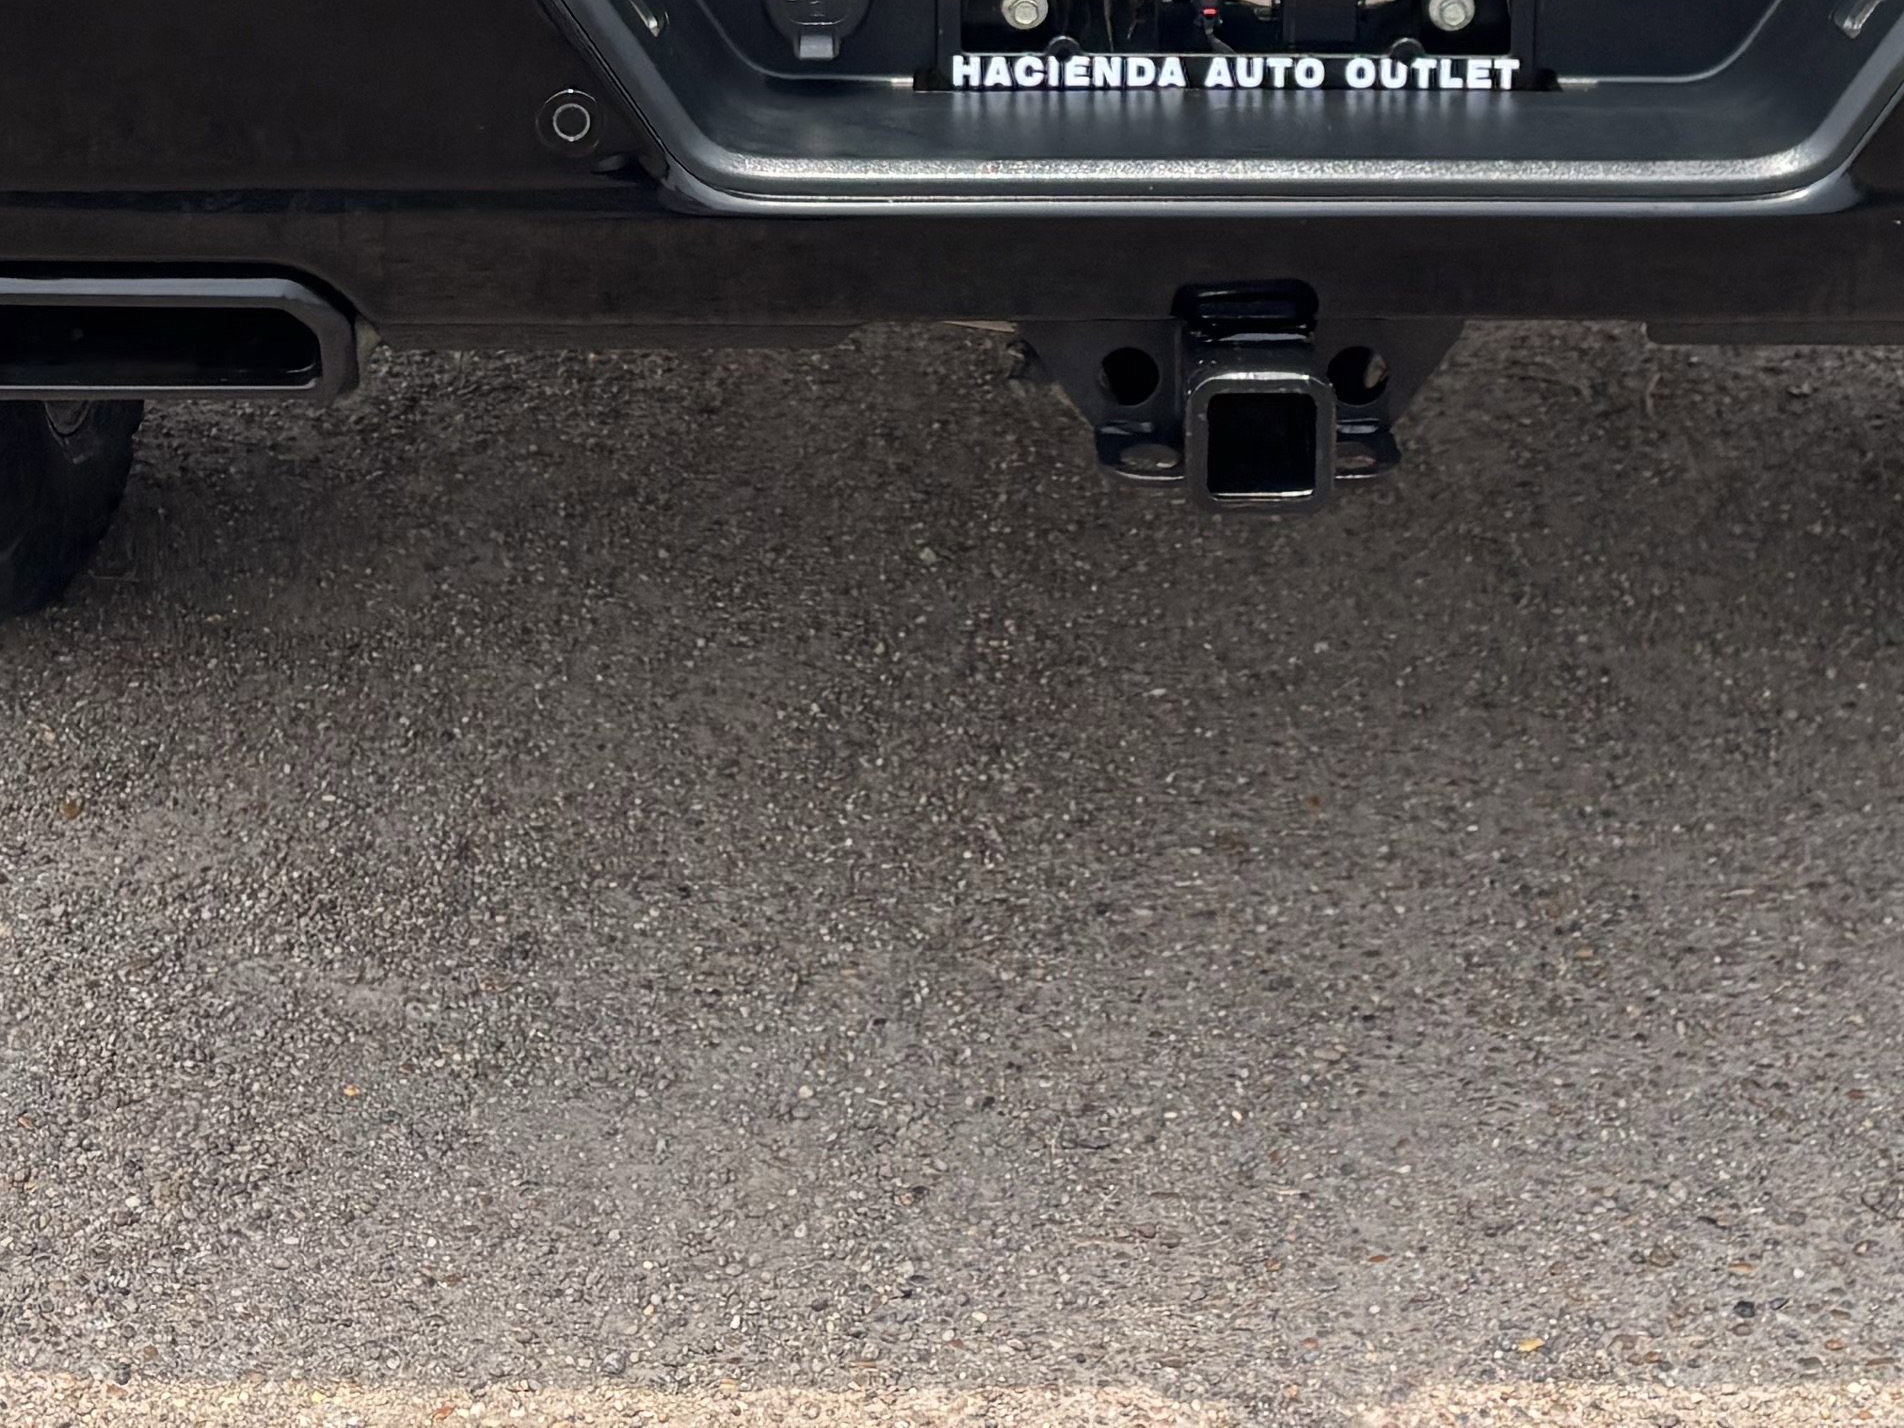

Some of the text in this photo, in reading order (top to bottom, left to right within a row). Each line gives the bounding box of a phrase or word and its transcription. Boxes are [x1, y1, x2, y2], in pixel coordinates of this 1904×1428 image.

[951, 55, 1521, 90] HACIENDA AUTO OUTLET
